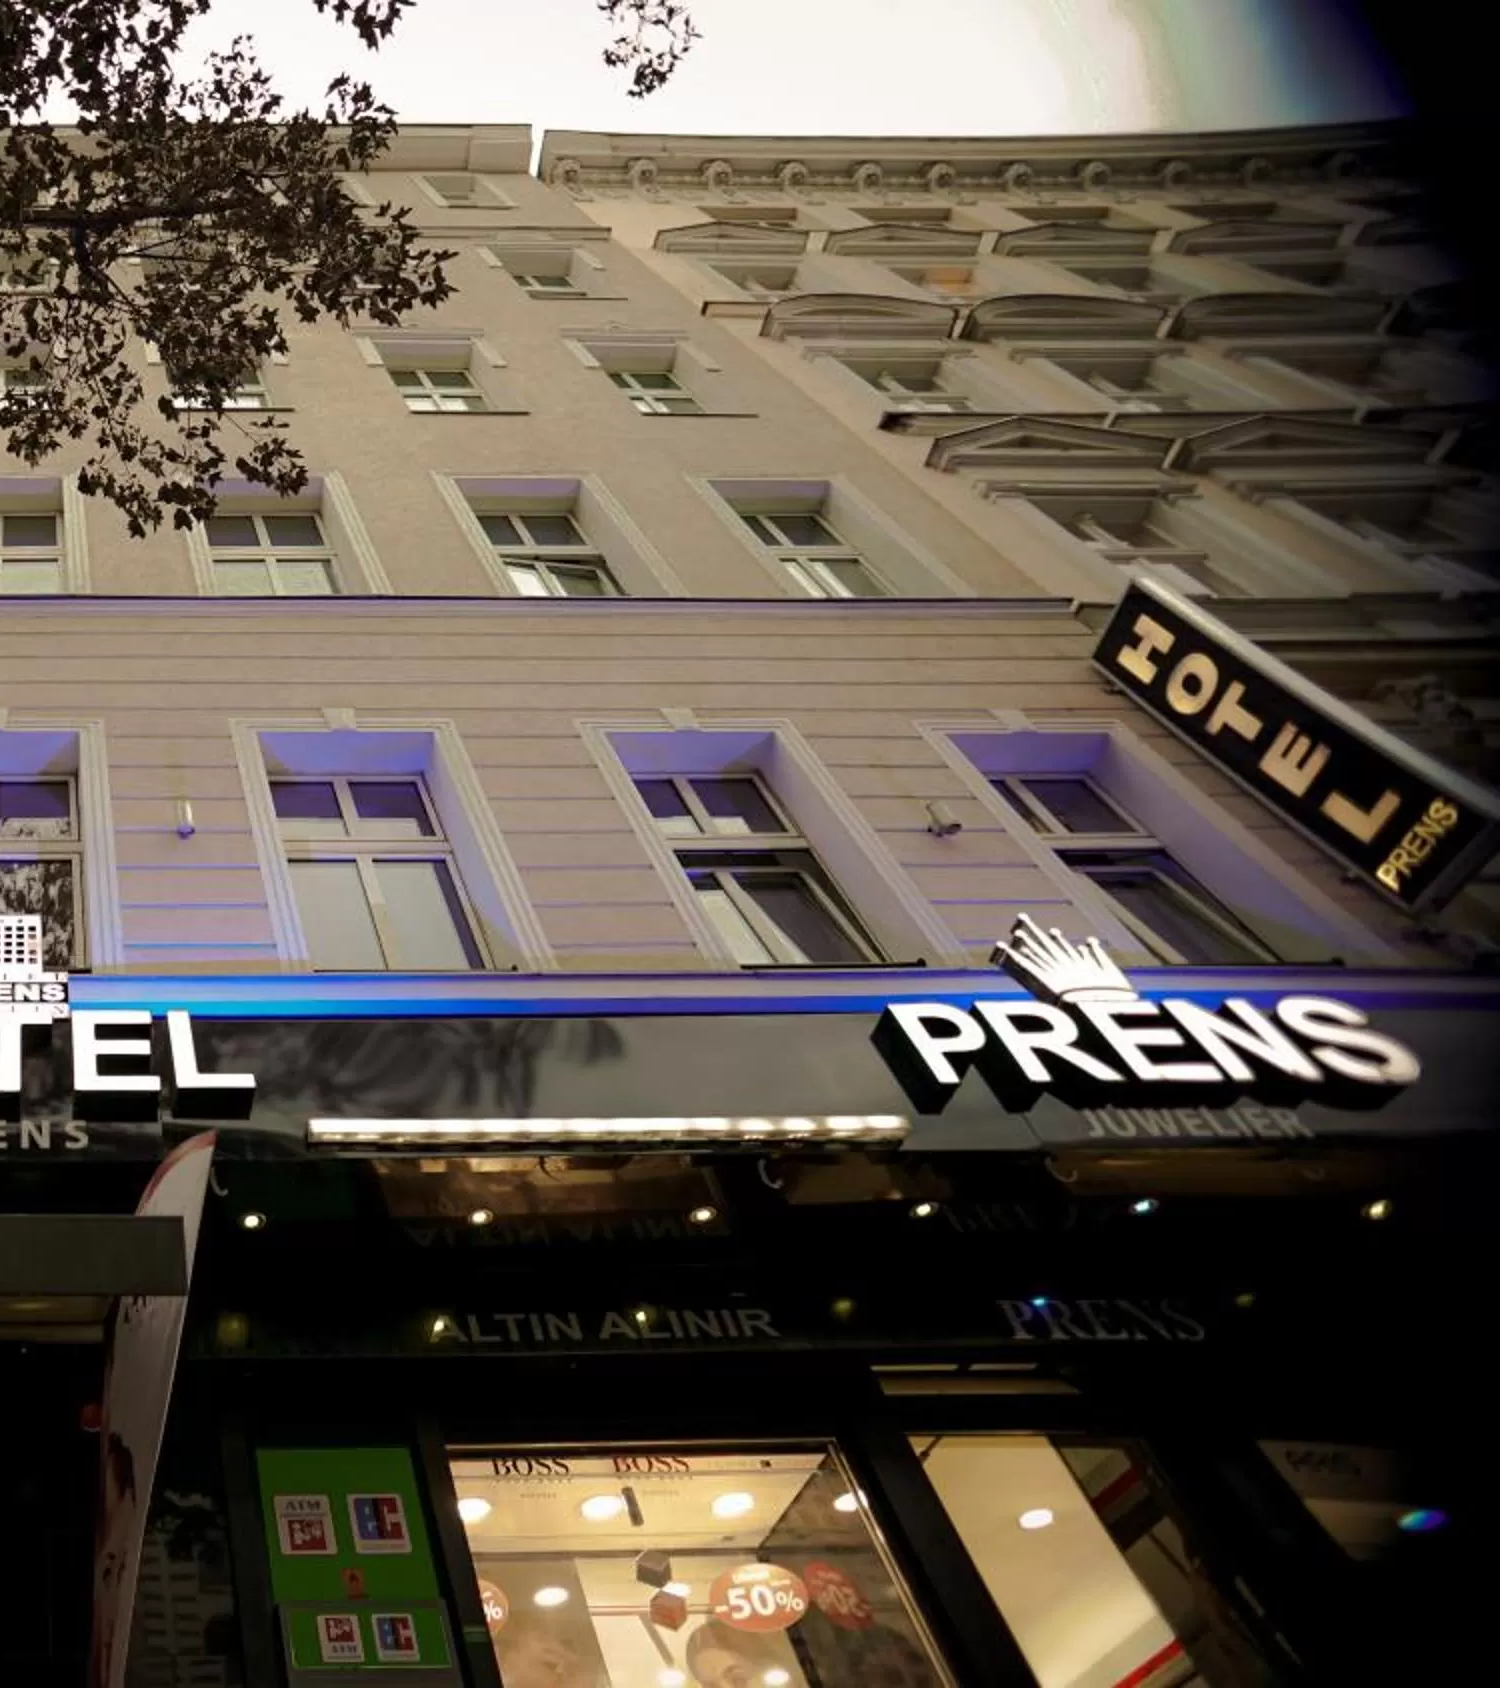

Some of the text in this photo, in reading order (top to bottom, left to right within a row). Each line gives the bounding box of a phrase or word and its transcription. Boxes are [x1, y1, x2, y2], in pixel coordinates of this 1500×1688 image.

[1115, 612, 1402, 845] HOTEL
[1376, 795, 1461, 893] PRENS
[886, 996, 1422, 1086] PRENS
[430, 1306, 780, 1344] ALTIN ALINIR
[996, 1299, 1206, 1342] PRENS
[491, 1455, 570, 1477] BOSS
[612, 1454, 691, 1474] BOSS
[285, 1500, 321, 1512] ATM
[715, 1585, 805, 1621] -50%
